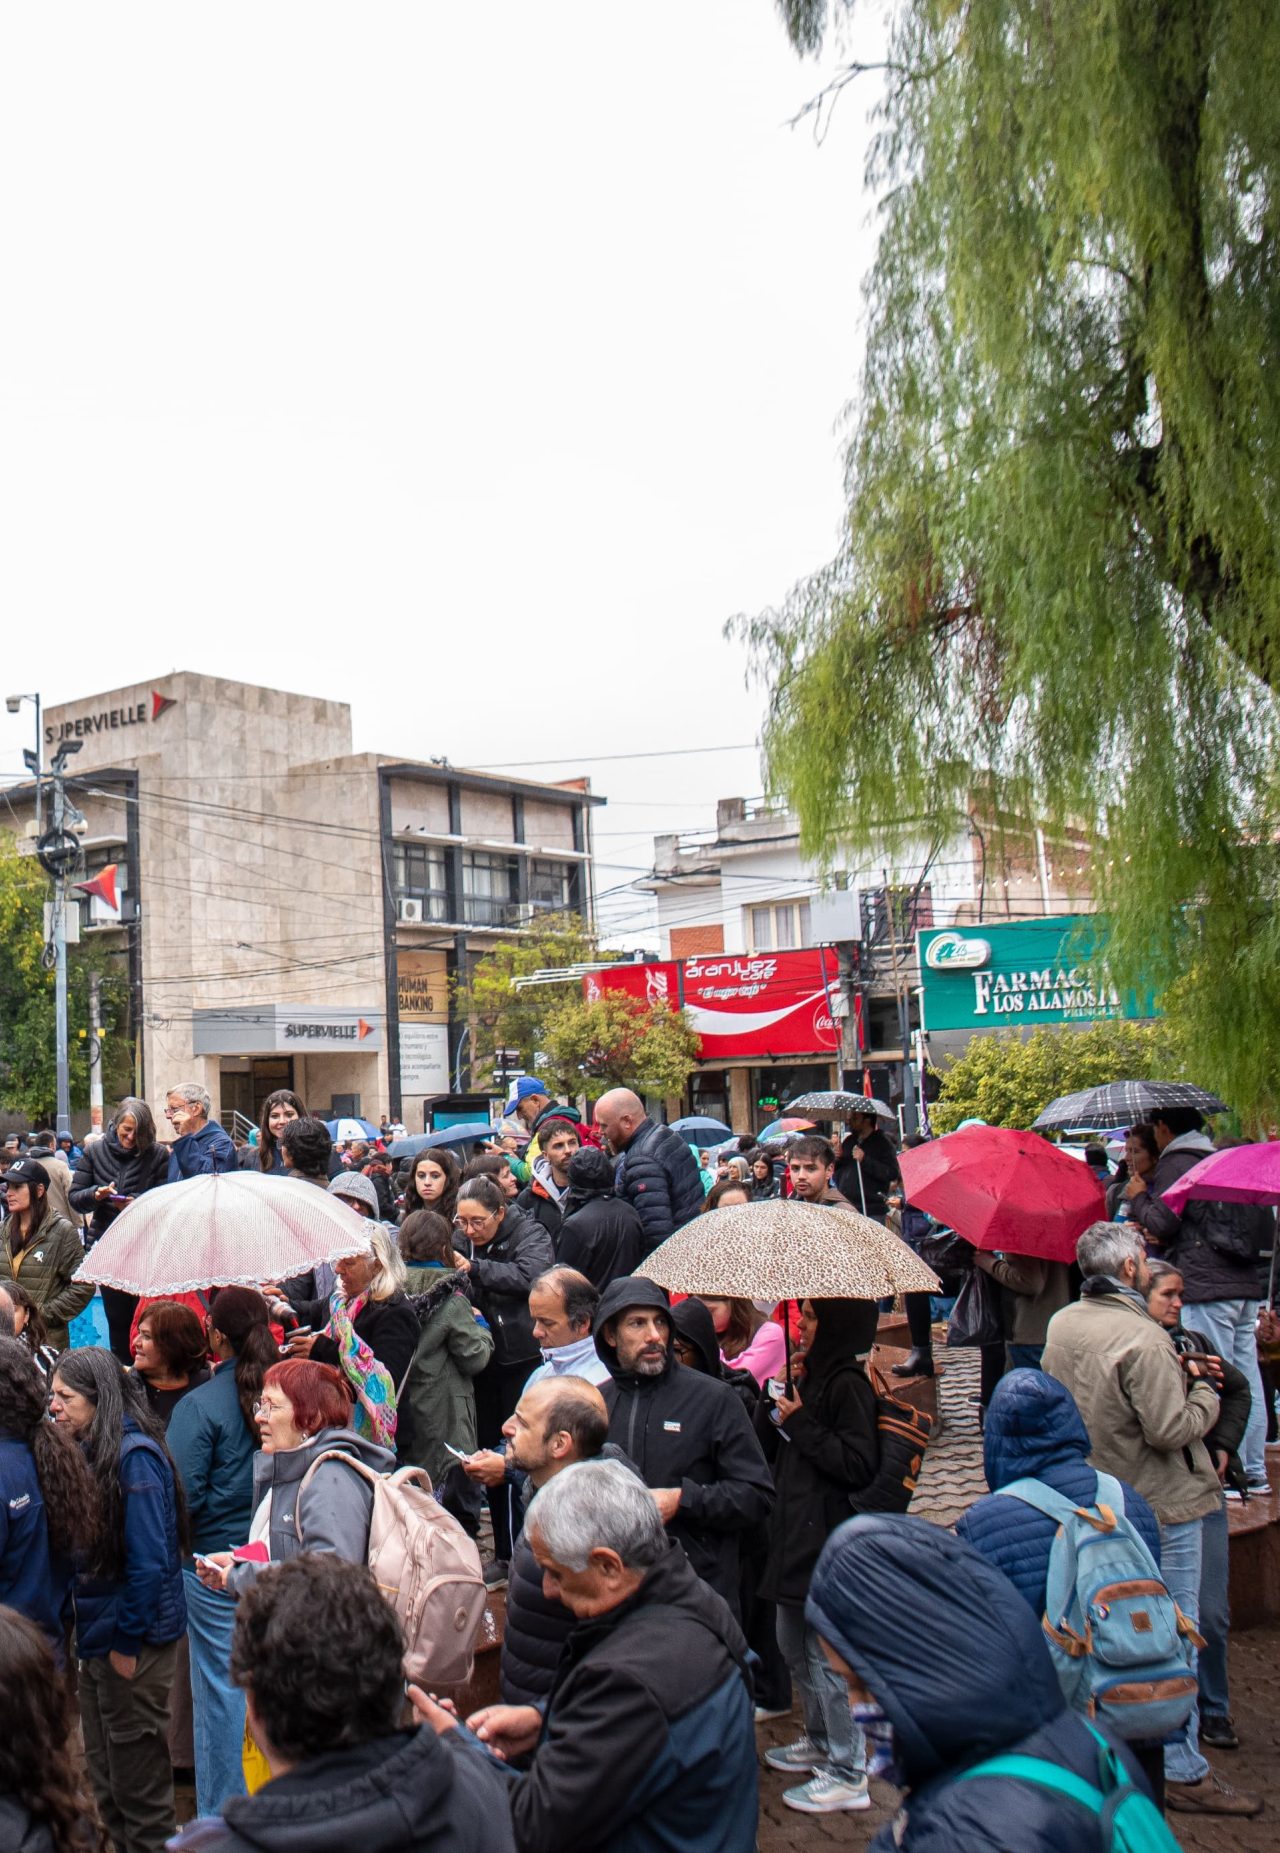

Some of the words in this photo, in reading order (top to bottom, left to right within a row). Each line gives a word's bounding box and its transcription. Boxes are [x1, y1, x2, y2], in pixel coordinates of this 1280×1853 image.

[399, 977, 428, 993] HUMAN
[399, 994, 434, 1012] BANKING
[993, 992, 1024, 1014] LOS
[1027, 989, 1096, 1011] ALAMOS
[285, 1023, 358, 1039] SUPERVIELLE
